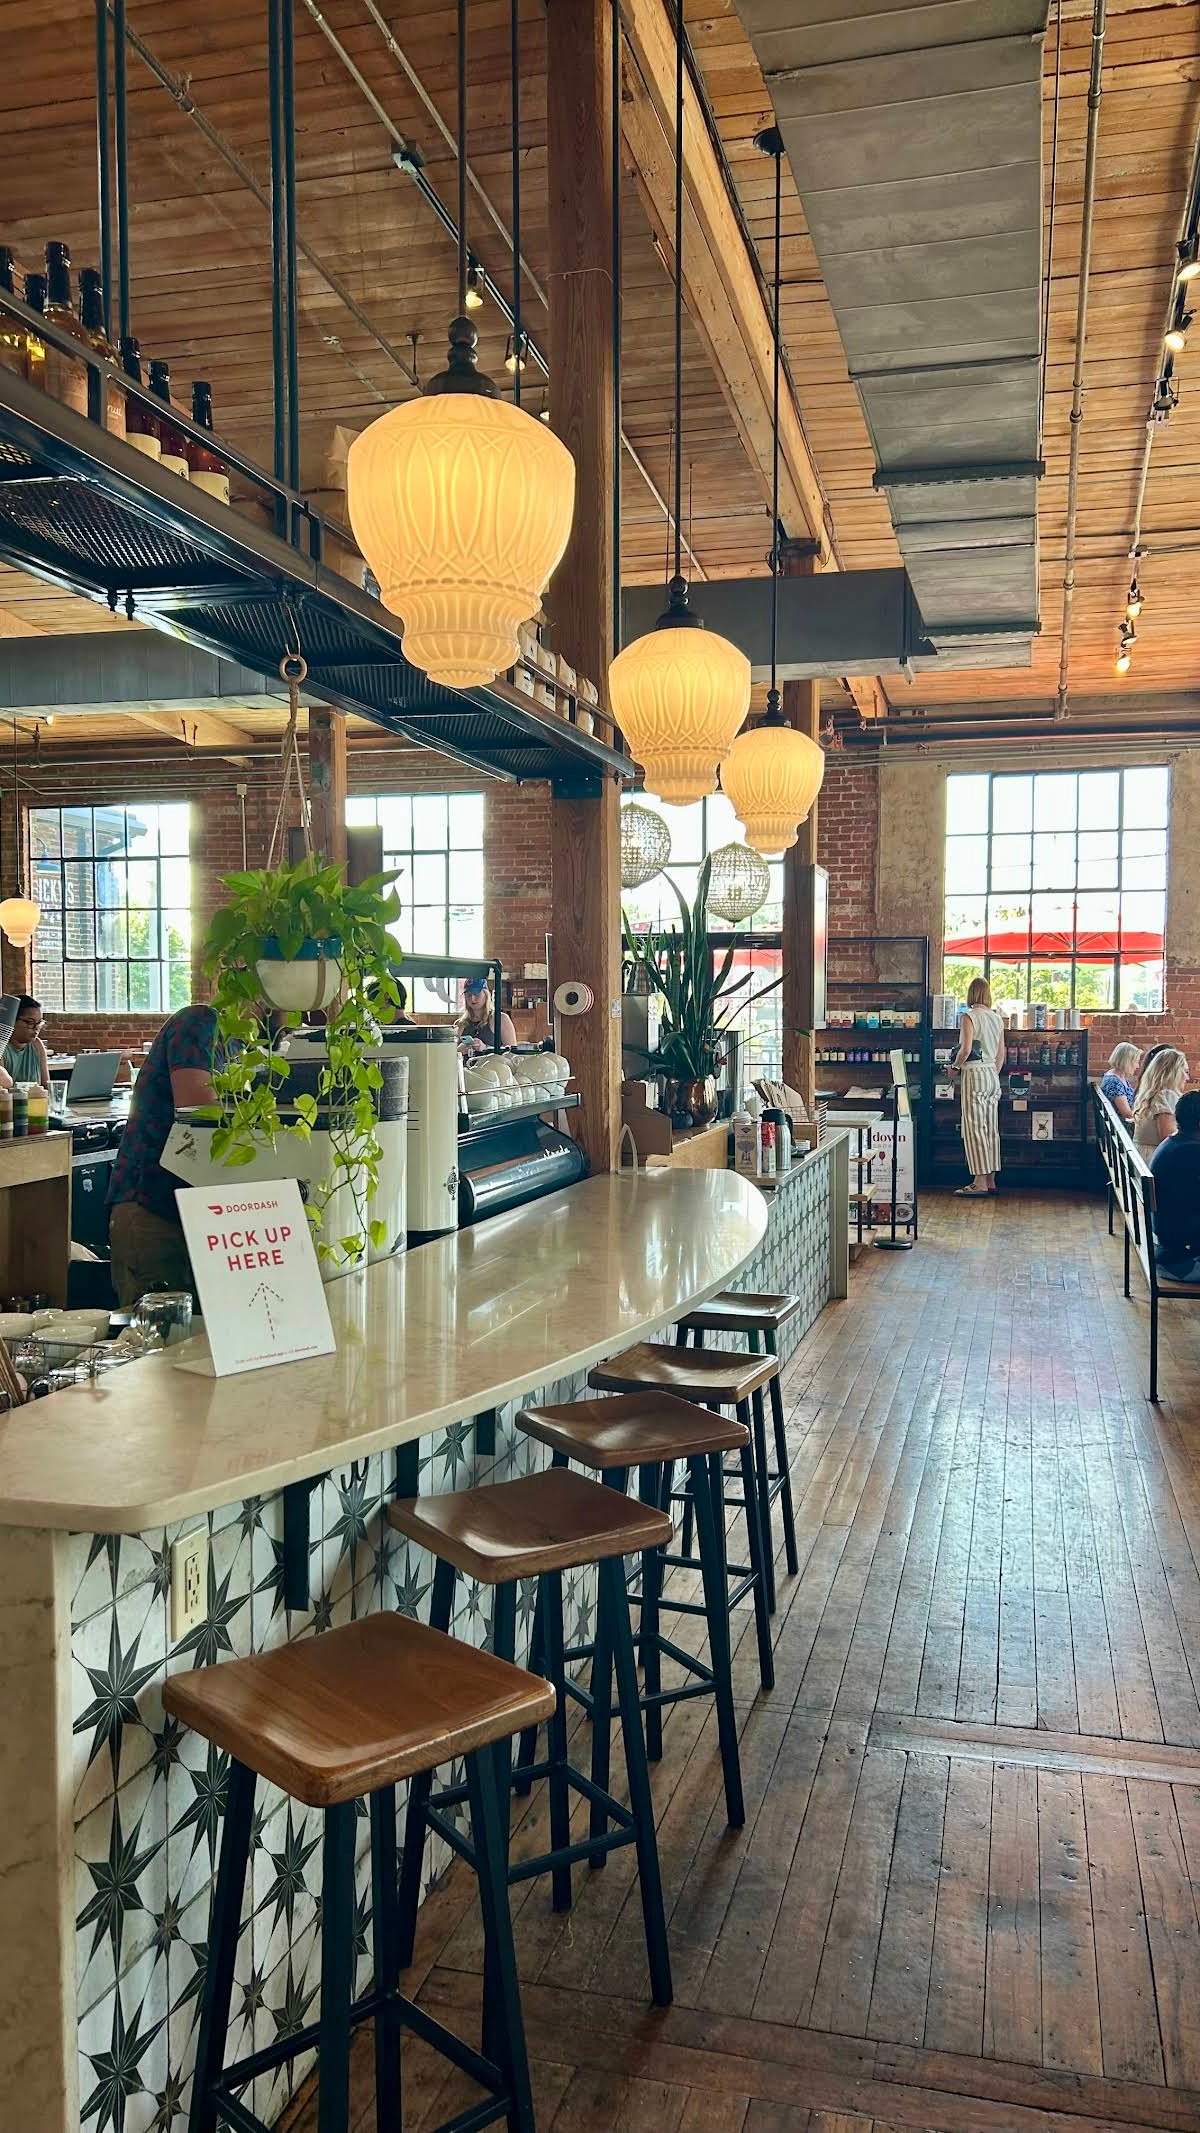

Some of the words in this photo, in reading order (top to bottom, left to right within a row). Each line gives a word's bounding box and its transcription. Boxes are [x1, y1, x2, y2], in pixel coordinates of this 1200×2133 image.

[226, 1201, 279, 1214] DOORDASH
[207, 1230, 259, 1251] PICK
[264, 1226, 292, 1244] UP
[227, 1249, 285, 1272] HERE
